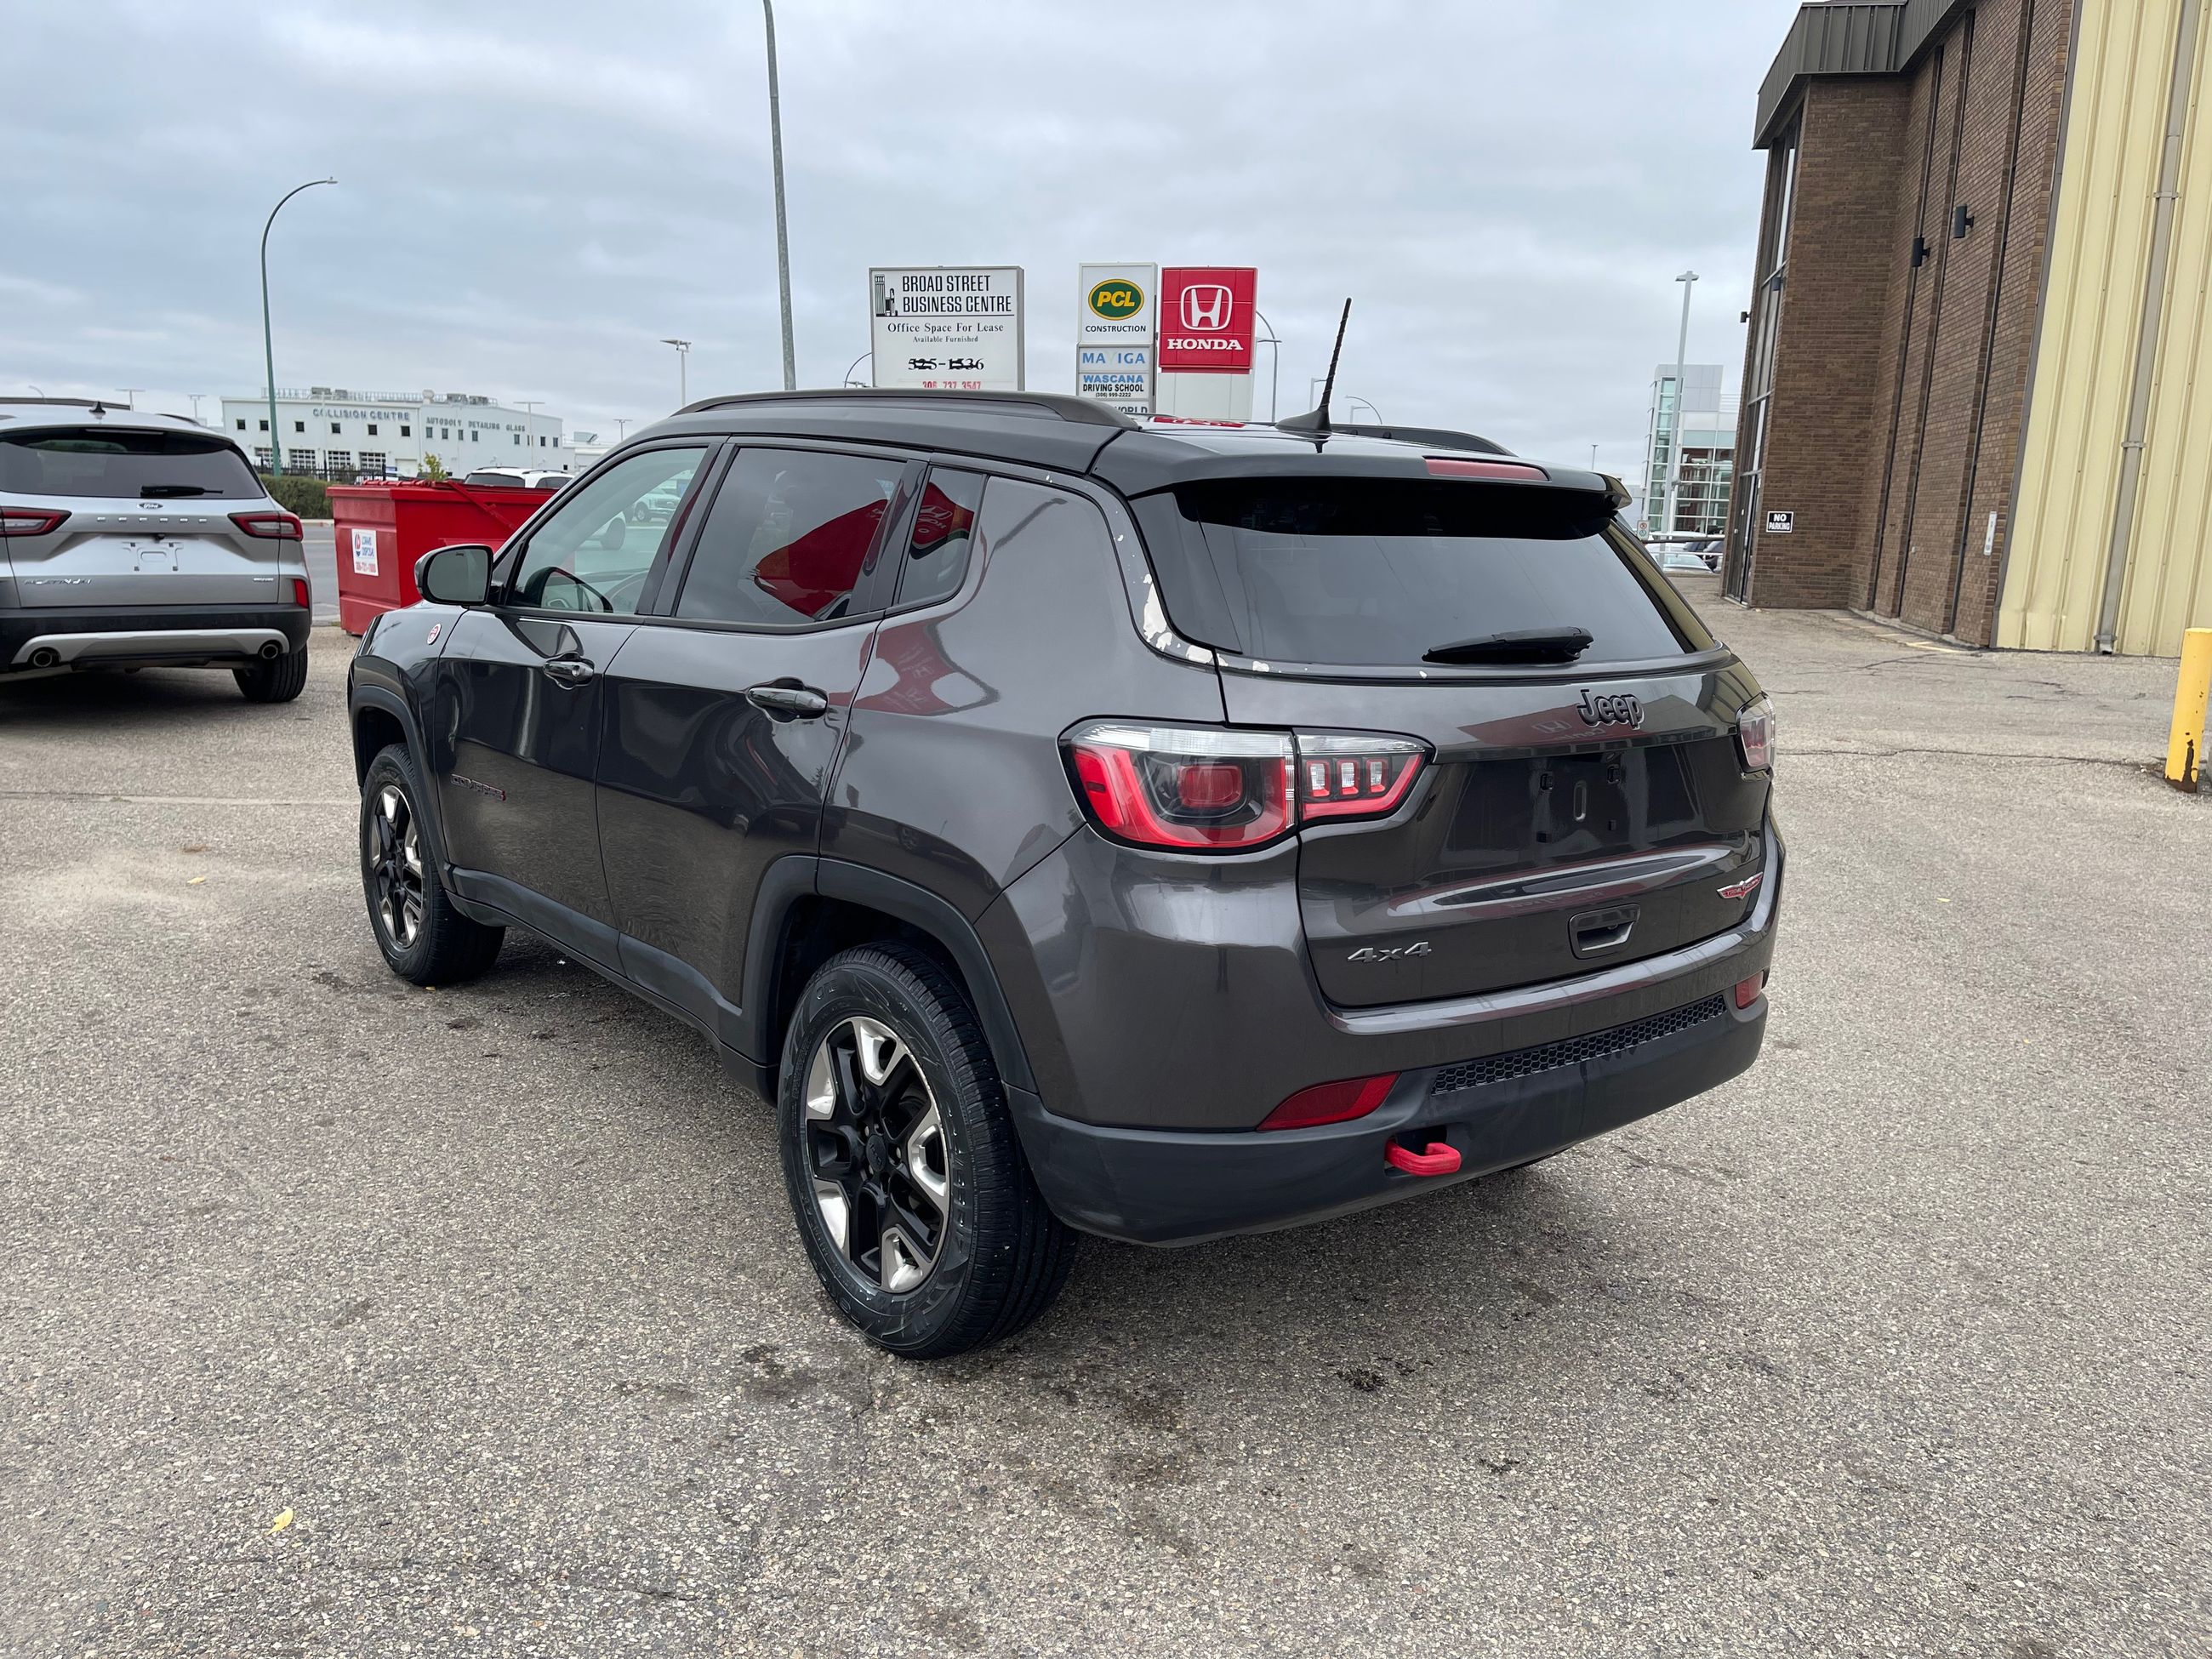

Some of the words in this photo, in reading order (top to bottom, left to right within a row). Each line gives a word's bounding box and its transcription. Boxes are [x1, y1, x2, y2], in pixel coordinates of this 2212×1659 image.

[903, 276, 943, 292] BROAD
[947, 275, 990, 291] STREET
[903, 296, 962, 312] BUSINESS
[966, 295, 1012, 312] CENTRE
[1097, 290, 1135, 307] PCL
[887, 322, 920, 333] Office
[924, 322, 952, 334] Space
[956, 322, 972, 332] For
[977, 322, 1004, 332] Lease
[1166, 339, 1244, 351] HONDA
[1083, 375, 1144, 384] WASCANA
[1082, 384, 1113, 392] DRIVING
[1115, 384, 1144, 392] SCHOOL
[369, 410, 410, 421] CENTRE
[1576, 688, 1645, 731] Jeep
[1347, 941, 1433, 963] 4x4
